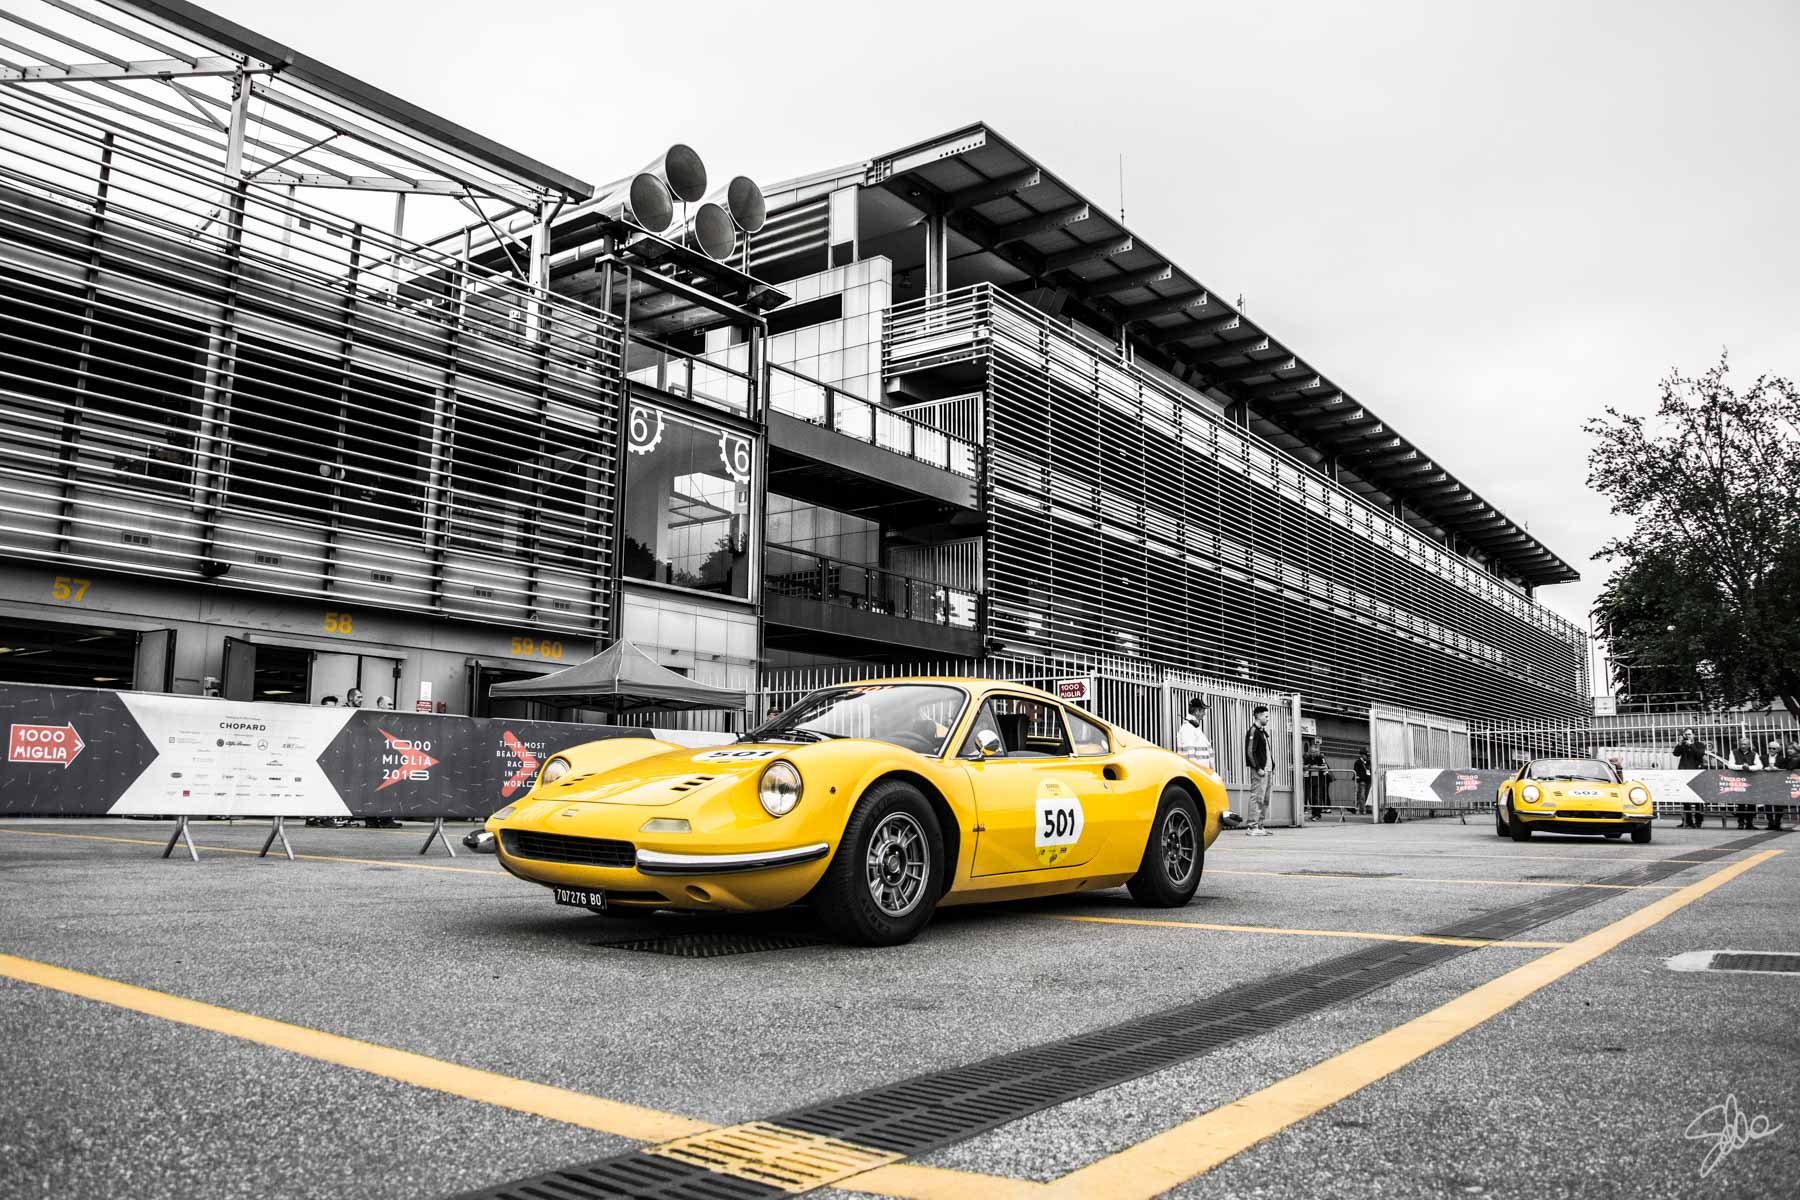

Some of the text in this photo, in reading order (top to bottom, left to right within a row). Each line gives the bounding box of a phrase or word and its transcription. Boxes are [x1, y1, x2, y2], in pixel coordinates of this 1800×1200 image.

[630, 406, 648, 443] 6
[734, 439, 750, 473] 6
[52, 576, 92, 602] 57
[323, 611, 353, 635] 58
[511, 636, 563, 660] 59-60
[1060, 690, 1081, 698] MIGLIA
[219, 722, 267, 732] CHOPARD
[19, 729, 66, 743] 1000
[384, 739, 432, 751] 1000
[499, 740, 546, 750] THE MOST
[14, 745, 68, 760] MIGLIA
[496, 750, 548, 759] BEAUTIFUL
[709, 750, 775, 758] 501
[382, 754, 432, 766] MIGLIA
[507, 760, 537, 768] RACE
[382, 769, 430, 781] 2018
[516, 770, 539, 778] THE
[1044, 808, 1076, 839] 501
[557, 888, 602, 906] 707276 BO
